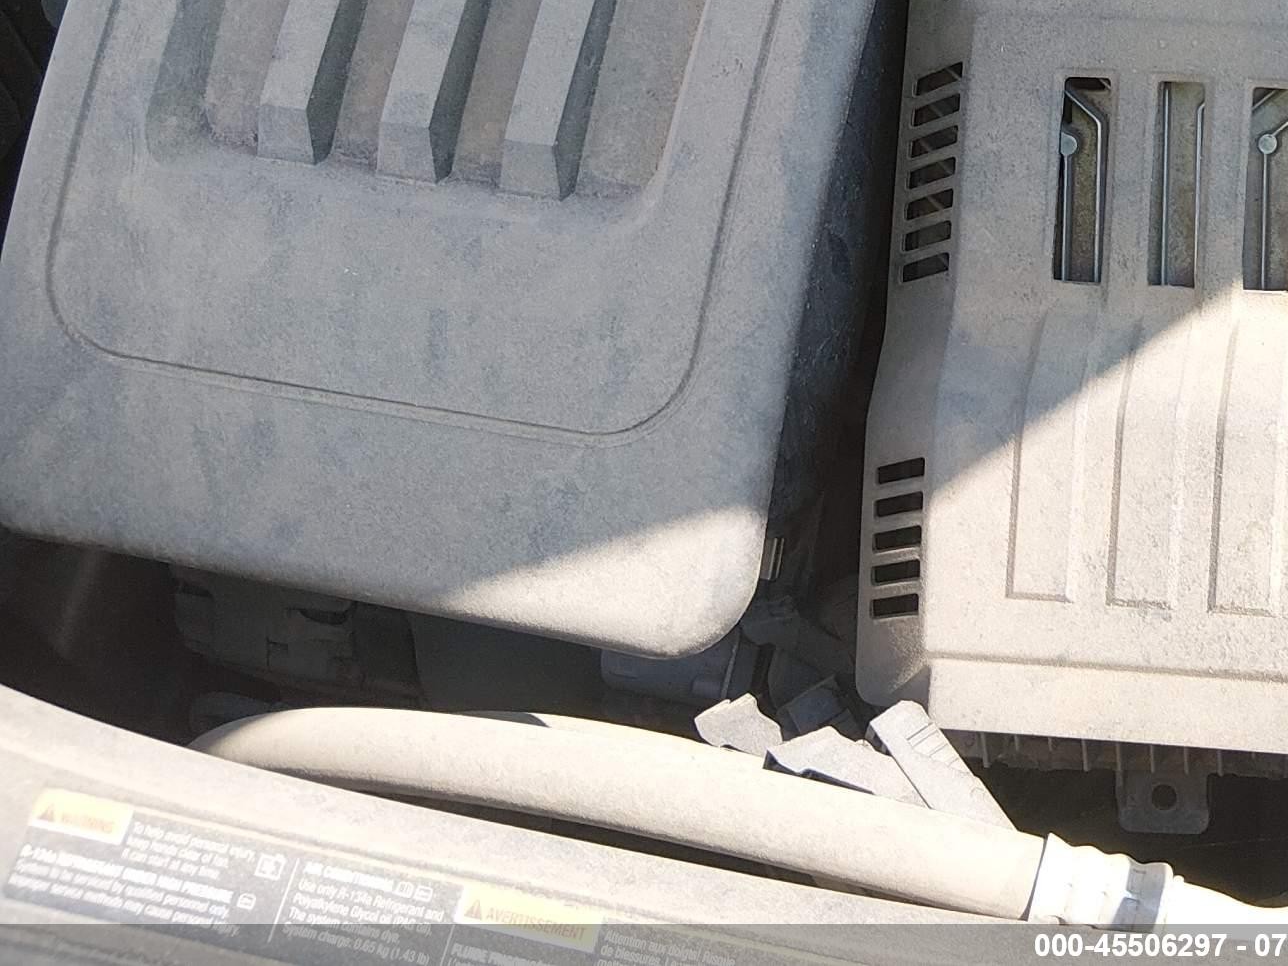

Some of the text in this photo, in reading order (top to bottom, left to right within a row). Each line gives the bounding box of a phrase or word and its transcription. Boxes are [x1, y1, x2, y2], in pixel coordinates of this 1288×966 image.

[144, 825, 164, 840] help
[164, 832, 192, 845] avoid
[189, 838, 229, 855] personal
[293, 892, 349, 916] Polyalkylene
[350, 906, 380, 922] Glycol
[299, 878, 444, 922] Use only R-134a Refrigerant and
[172, 912, 213, 929] personal
[289, 906, 306, 921] The
[307, 914, 340, 929] system
[341, 921, 380, 938] contains
[486, 907, 586, 940] AVERTISSEMENT
[282, 922, 317, 939] System
[318, 930, 353, 948] charge:
[353, 938, 376, 953] 0.65
[376, 943, 390, 959] kg
[390, 946, 416, 962] (1.43
[416, 952, 430, 966] lb)
[604, 930, 646, 950] Attention
[648, 942, 666, 954] aux
